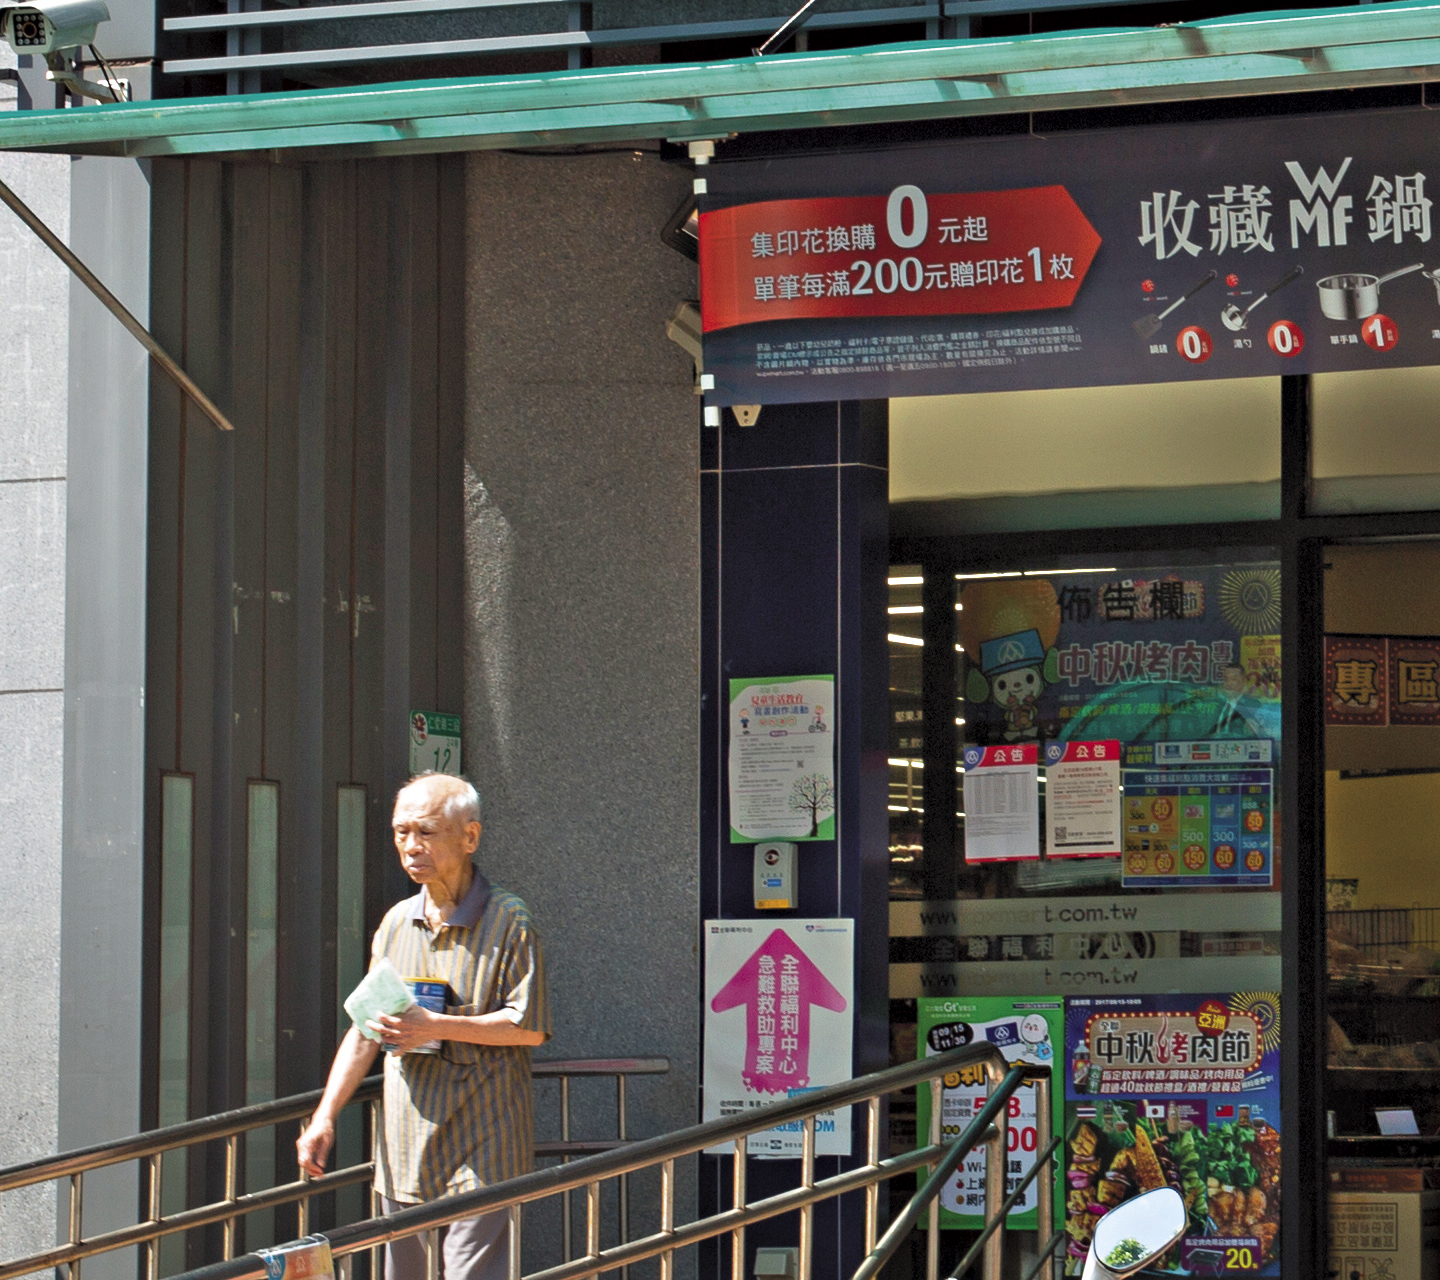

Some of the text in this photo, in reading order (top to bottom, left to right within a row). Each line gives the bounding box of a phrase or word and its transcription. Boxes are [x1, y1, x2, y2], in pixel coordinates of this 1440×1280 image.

[994, 749, 1023, 763] 公告
[1076, 744, 1106, 758] 公告
[755, 953, 777, 1075] 急難救助專案
[778, 953, 800, 1075] 全聯福利中心
[1095, 1029, 1251, 1065] 中秋烤肉節
[973, 1096, 1022, 1119] 58
